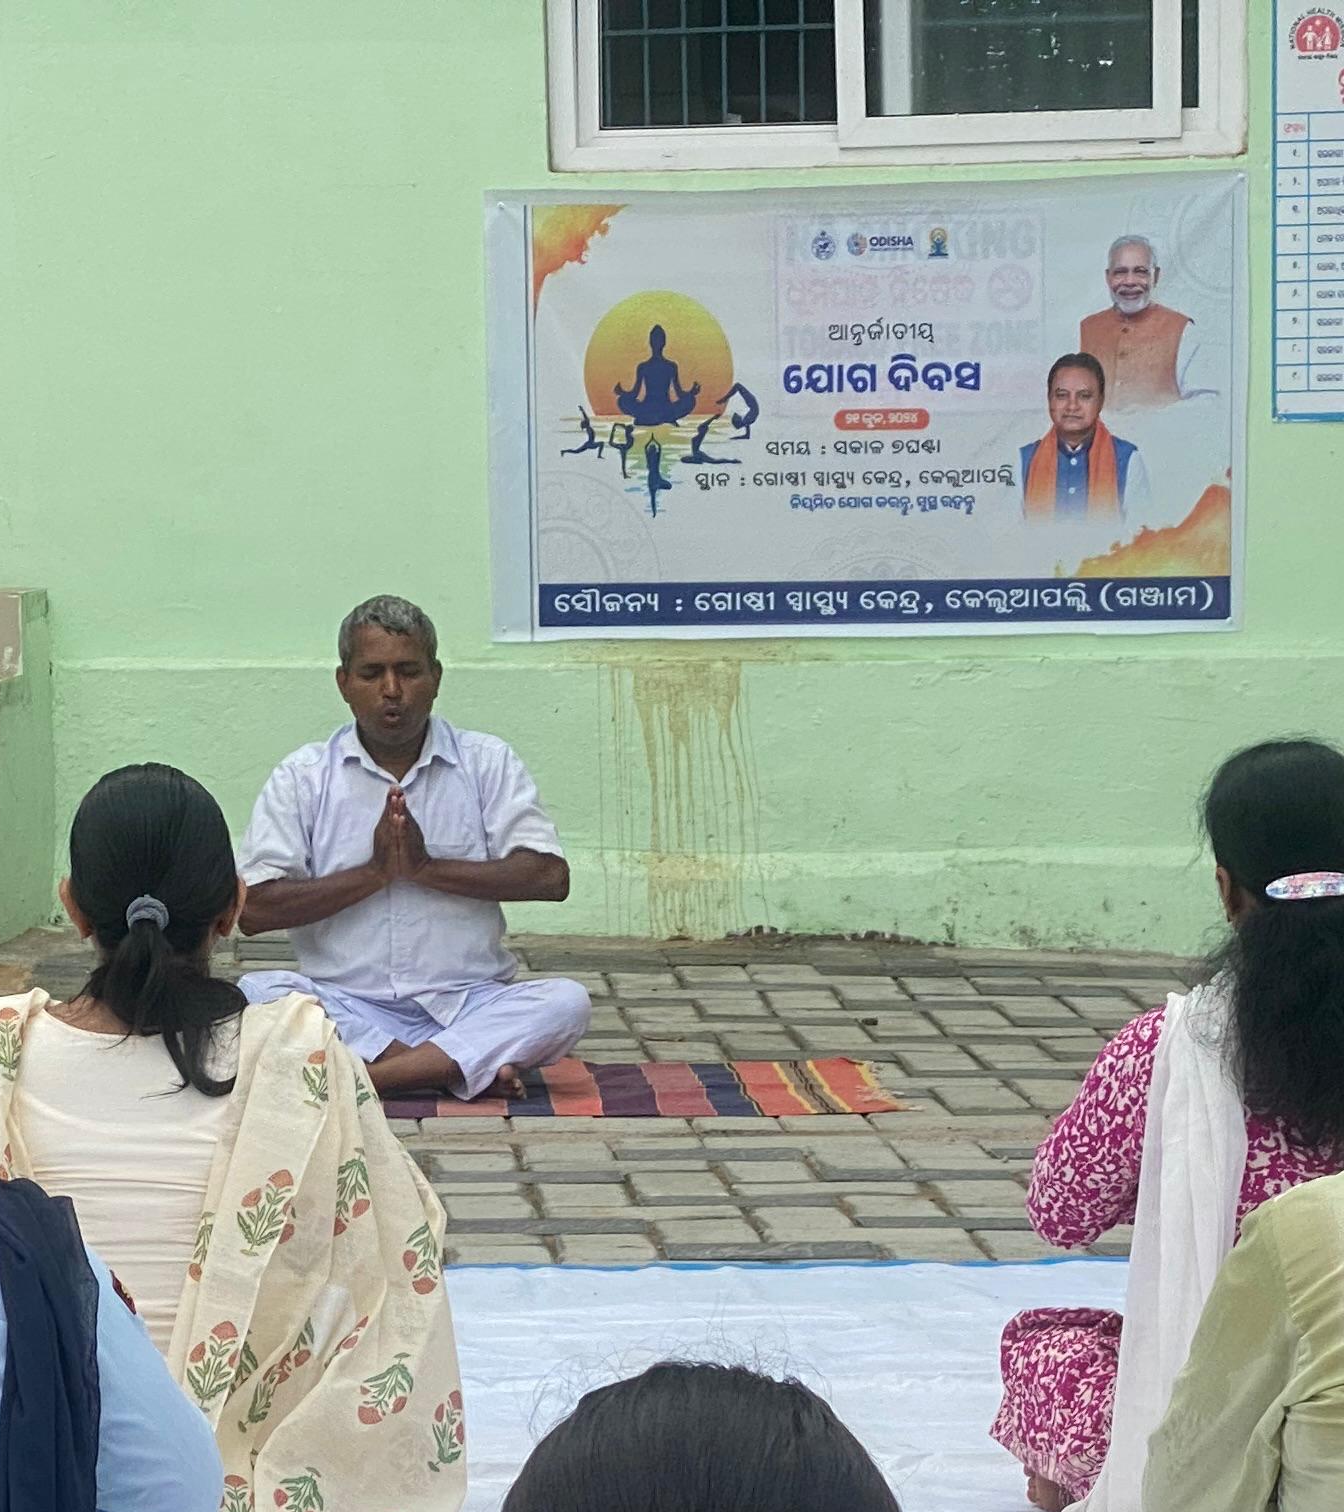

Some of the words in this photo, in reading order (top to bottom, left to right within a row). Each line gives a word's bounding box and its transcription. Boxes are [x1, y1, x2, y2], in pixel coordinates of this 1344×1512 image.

[869, 236, 914, 247] ODISHA
[828, 316, 935, 346] ଆନ୍ତର୍ଜାତୀୟ
[783, 363, 878, 394] ଯୋଗ
[887, 353, 982, 392] ଦିବସ
[765, 440, 812, 456] ସମୟ
[833, 439, 885, 455] ସକାଳ
[694, 471, 730, 491] ସ୍ଥାନ
[790, 493, 835, 511] ନିୟମିତ
[838, 496, 873, 509] ଯୋଗ
[554, 588, 659, 614] ସୌଜନ୍ୟ
[1100, 580, 1215, 612] (ଗଞ୍ଜାମ)
